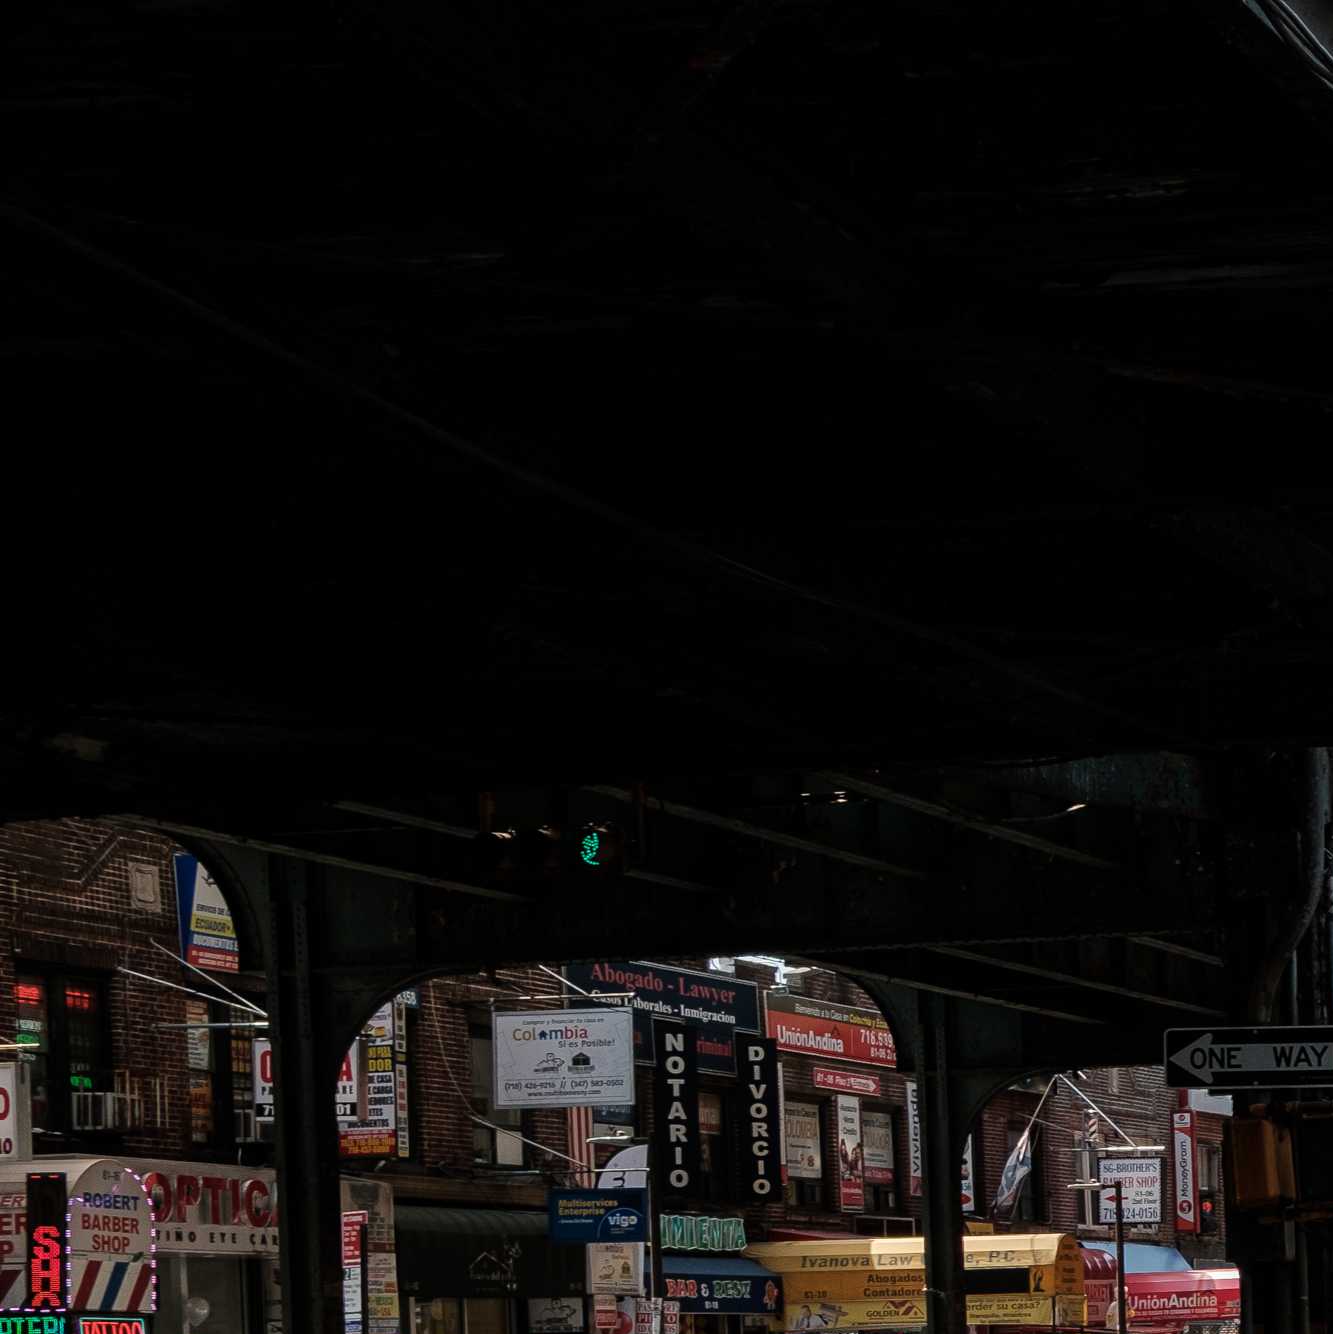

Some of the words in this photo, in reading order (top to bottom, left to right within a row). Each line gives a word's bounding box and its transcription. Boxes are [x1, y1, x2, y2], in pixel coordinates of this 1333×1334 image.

[591, 960, 663, 992] Abogado
[678, 977, 736, 1006] Lawyer
[624, 997, 672, 1015] Laborales
[512, 1026, 588, 1041] Colmbia
[776, 1024, 844, 1053] UniónAndina
[1190, 1047, 1242, 1068] ONE
[1273, 1046, 1328, 1067] WAY
[664, 1033, 690, 1188] NOTARIO
[747, 1045, 771, 1195] DIVORCIO
[910, 1087, 922, 1174] Vivienda
[1180, 1140, 1189, 1197] MoneyGram
[1136, 1176, 1158, 1188] SHOP
[83, 1192, 139, 1211] ROBERT
[145, 1171, 280, 1228] OPTIC
[607, 1213, 638, 1228] vigo
[1103, 1207, 1158, 1219] 71824-0156
[82, 1213, 140, 1234] BARBER
[92, 1234, 130, 1252] SHOP
[209, 1232, 237, 1245] EYE
[249, 1233, 280, 1247] CAR
[800, 1255, 870, 1268] Ivanova
[877, 1253, 914, 1267] Law
[866, 1273, 924, 1285] Abogados
[664, 1279, 698, 1298] BAR
[863, 1287, 927, 1298] Contadore
[996, 1303, 1008, 1311] su
[1011, 1301, 1041, 1311] casa?
[1128, 1293, 1218, 1310] UniónAndina
[866, 1309, 900, 1318] GOLDEN
